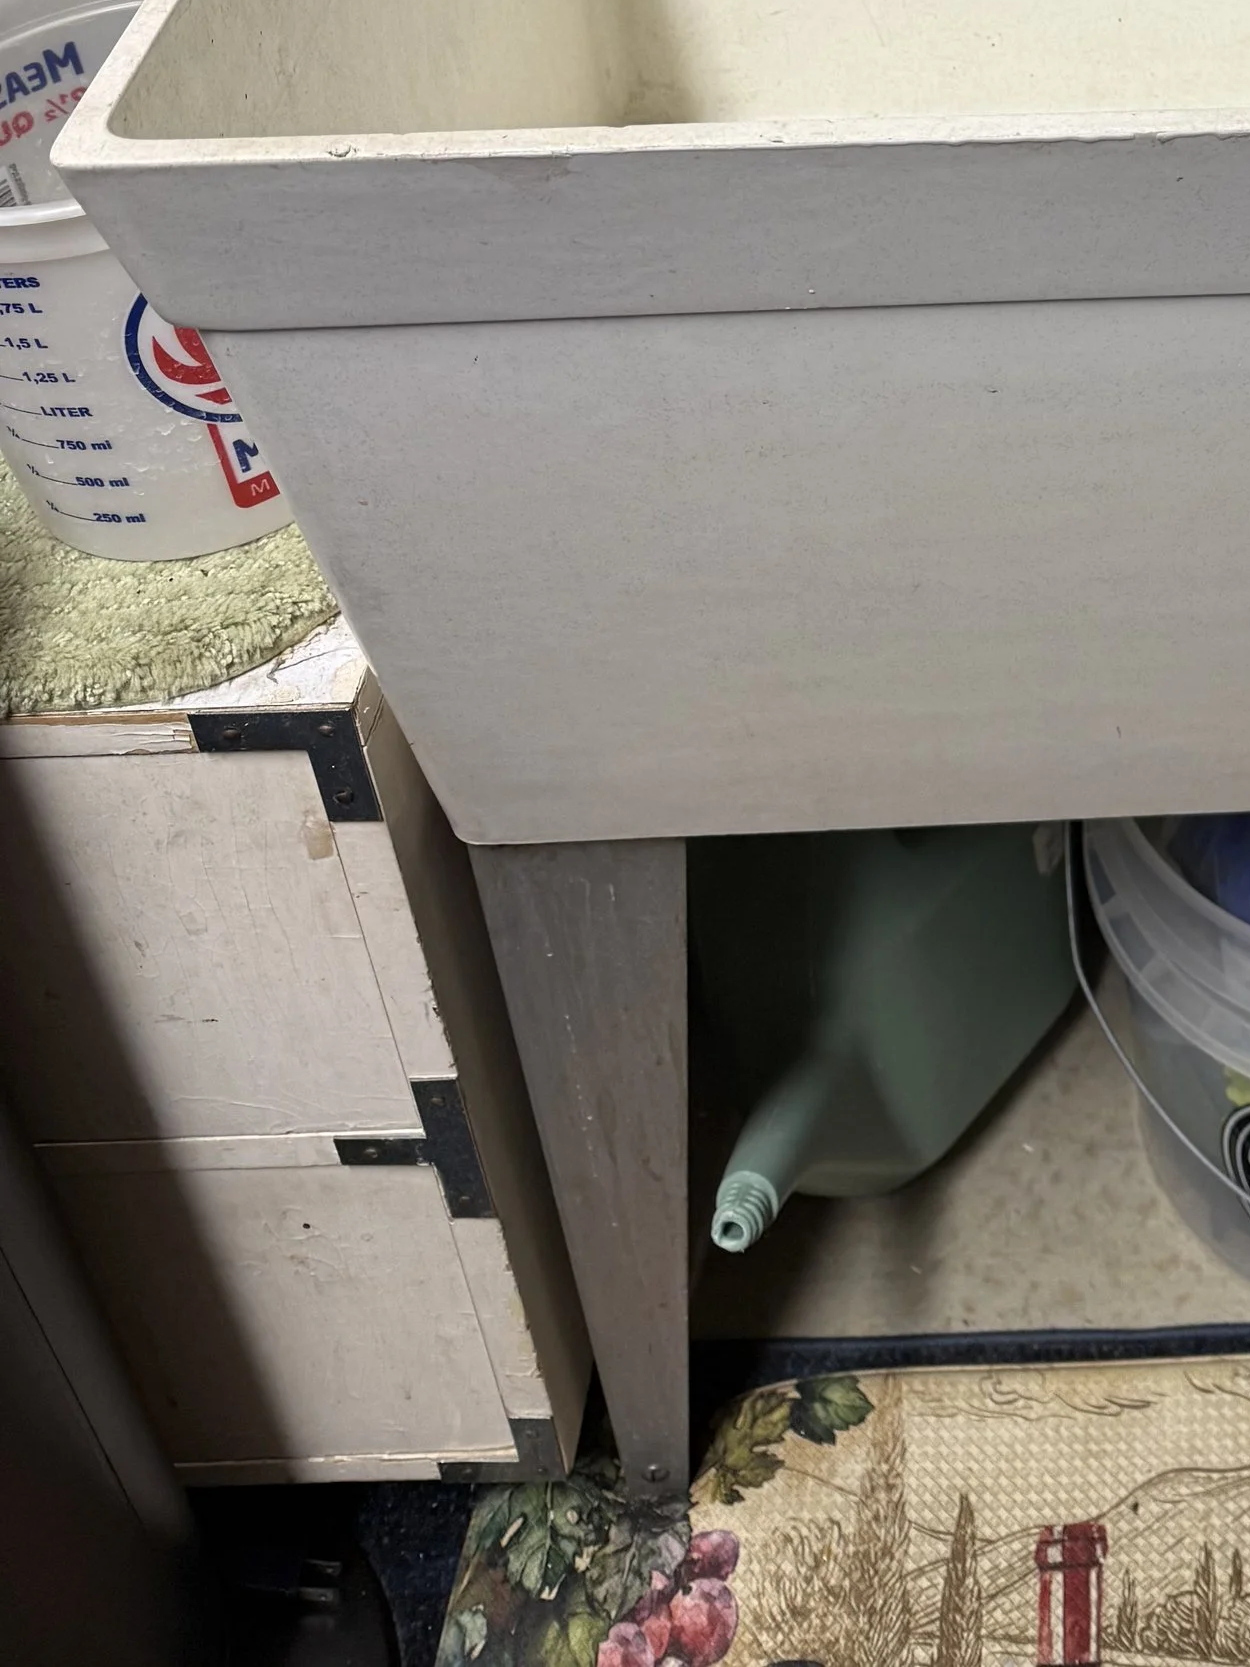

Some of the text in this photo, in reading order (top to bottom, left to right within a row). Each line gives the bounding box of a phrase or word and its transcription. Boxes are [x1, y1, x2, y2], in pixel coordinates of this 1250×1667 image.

[28, 303, 43, 314] L
[4, 337, 48, 350] 1,5 L
[22, 371, 76, 384] 1,25 L
[40, 406, 93, 417] LITER
[56, 439, 87, 450] 750
[75, 476, 105, 487] 500
[109, 477, 130, 487] ml
[93, 512, 122, 523] 250
[125, 513, 146, 523] ml
